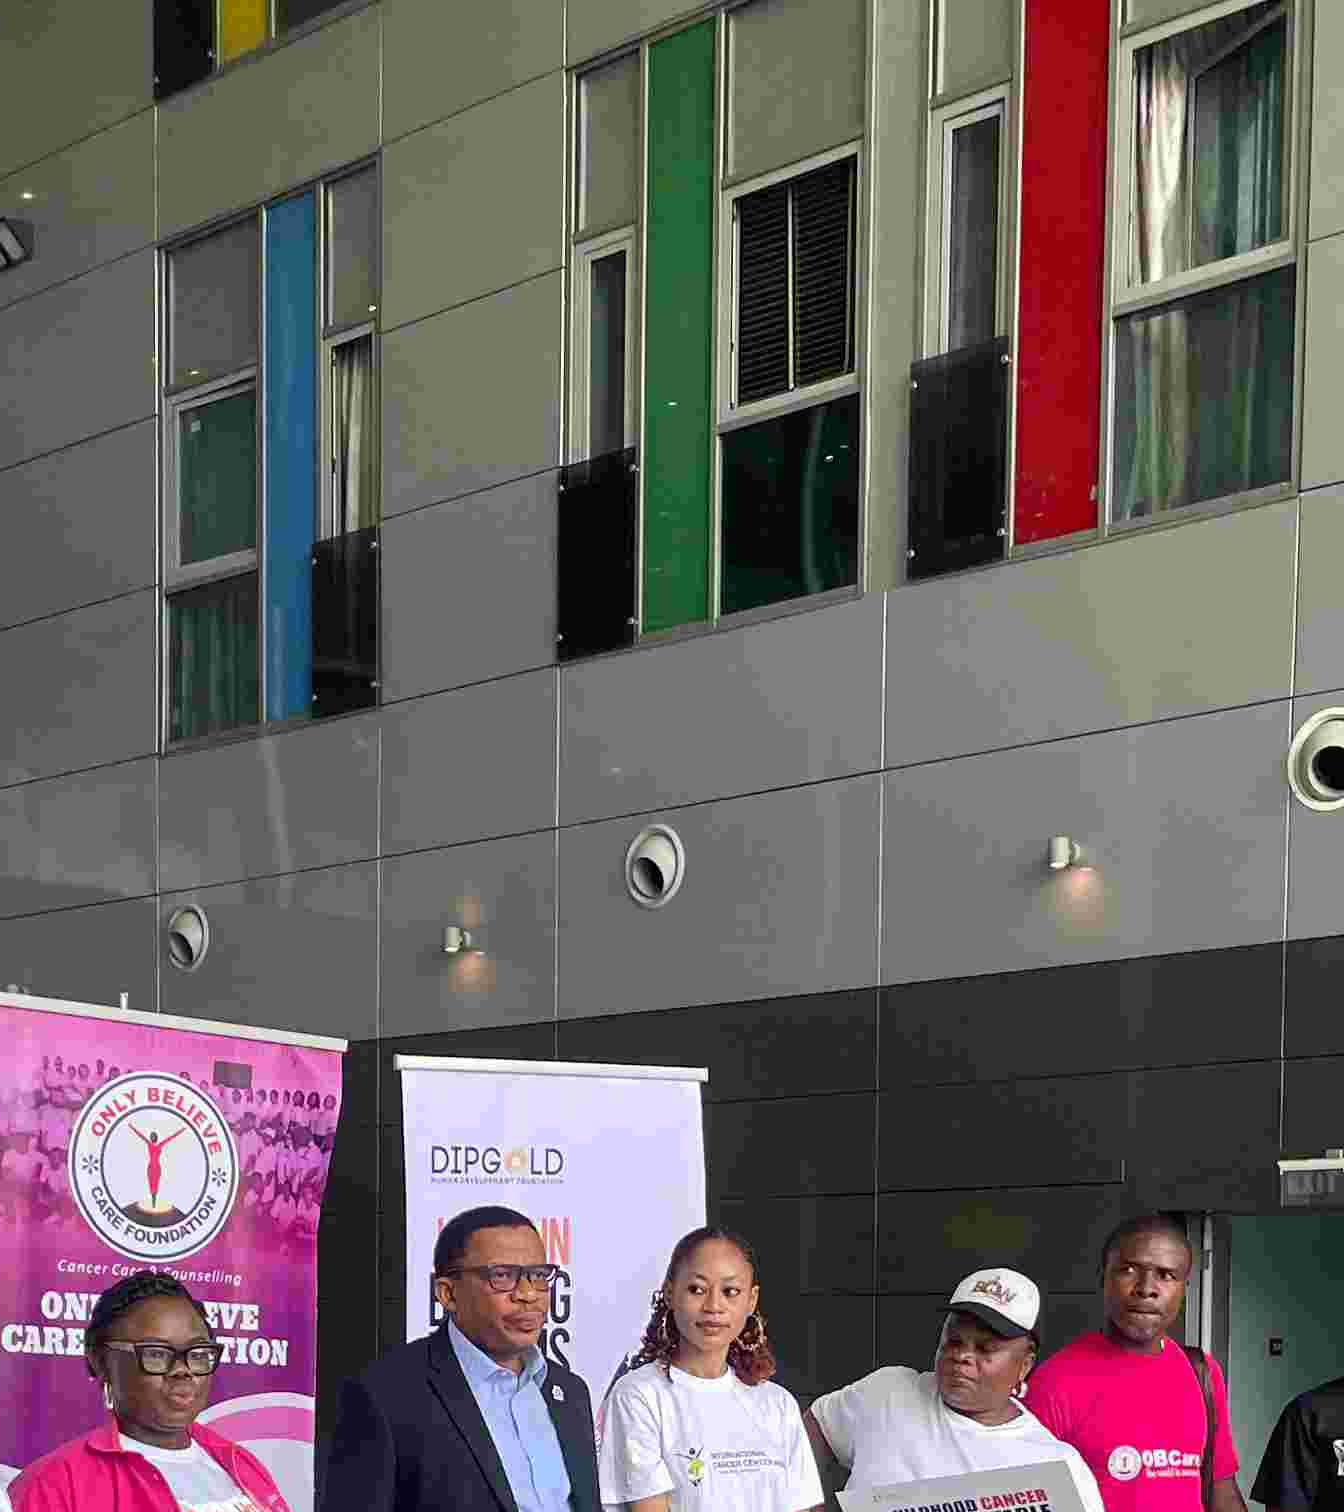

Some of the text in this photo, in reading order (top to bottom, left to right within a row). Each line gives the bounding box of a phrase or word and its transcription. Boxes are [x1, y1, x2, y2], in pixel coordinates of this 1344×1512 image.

[91, 1088, 222, 1153] ONLY BELIEVE
[91, 1186, 216, 1245] CARE FOUNDATION
[57, 1259, 108, 1275] Cancer
[1, 1324, 85, 1356] CARE
[979, 1488, 1048, 1511] CANCER
